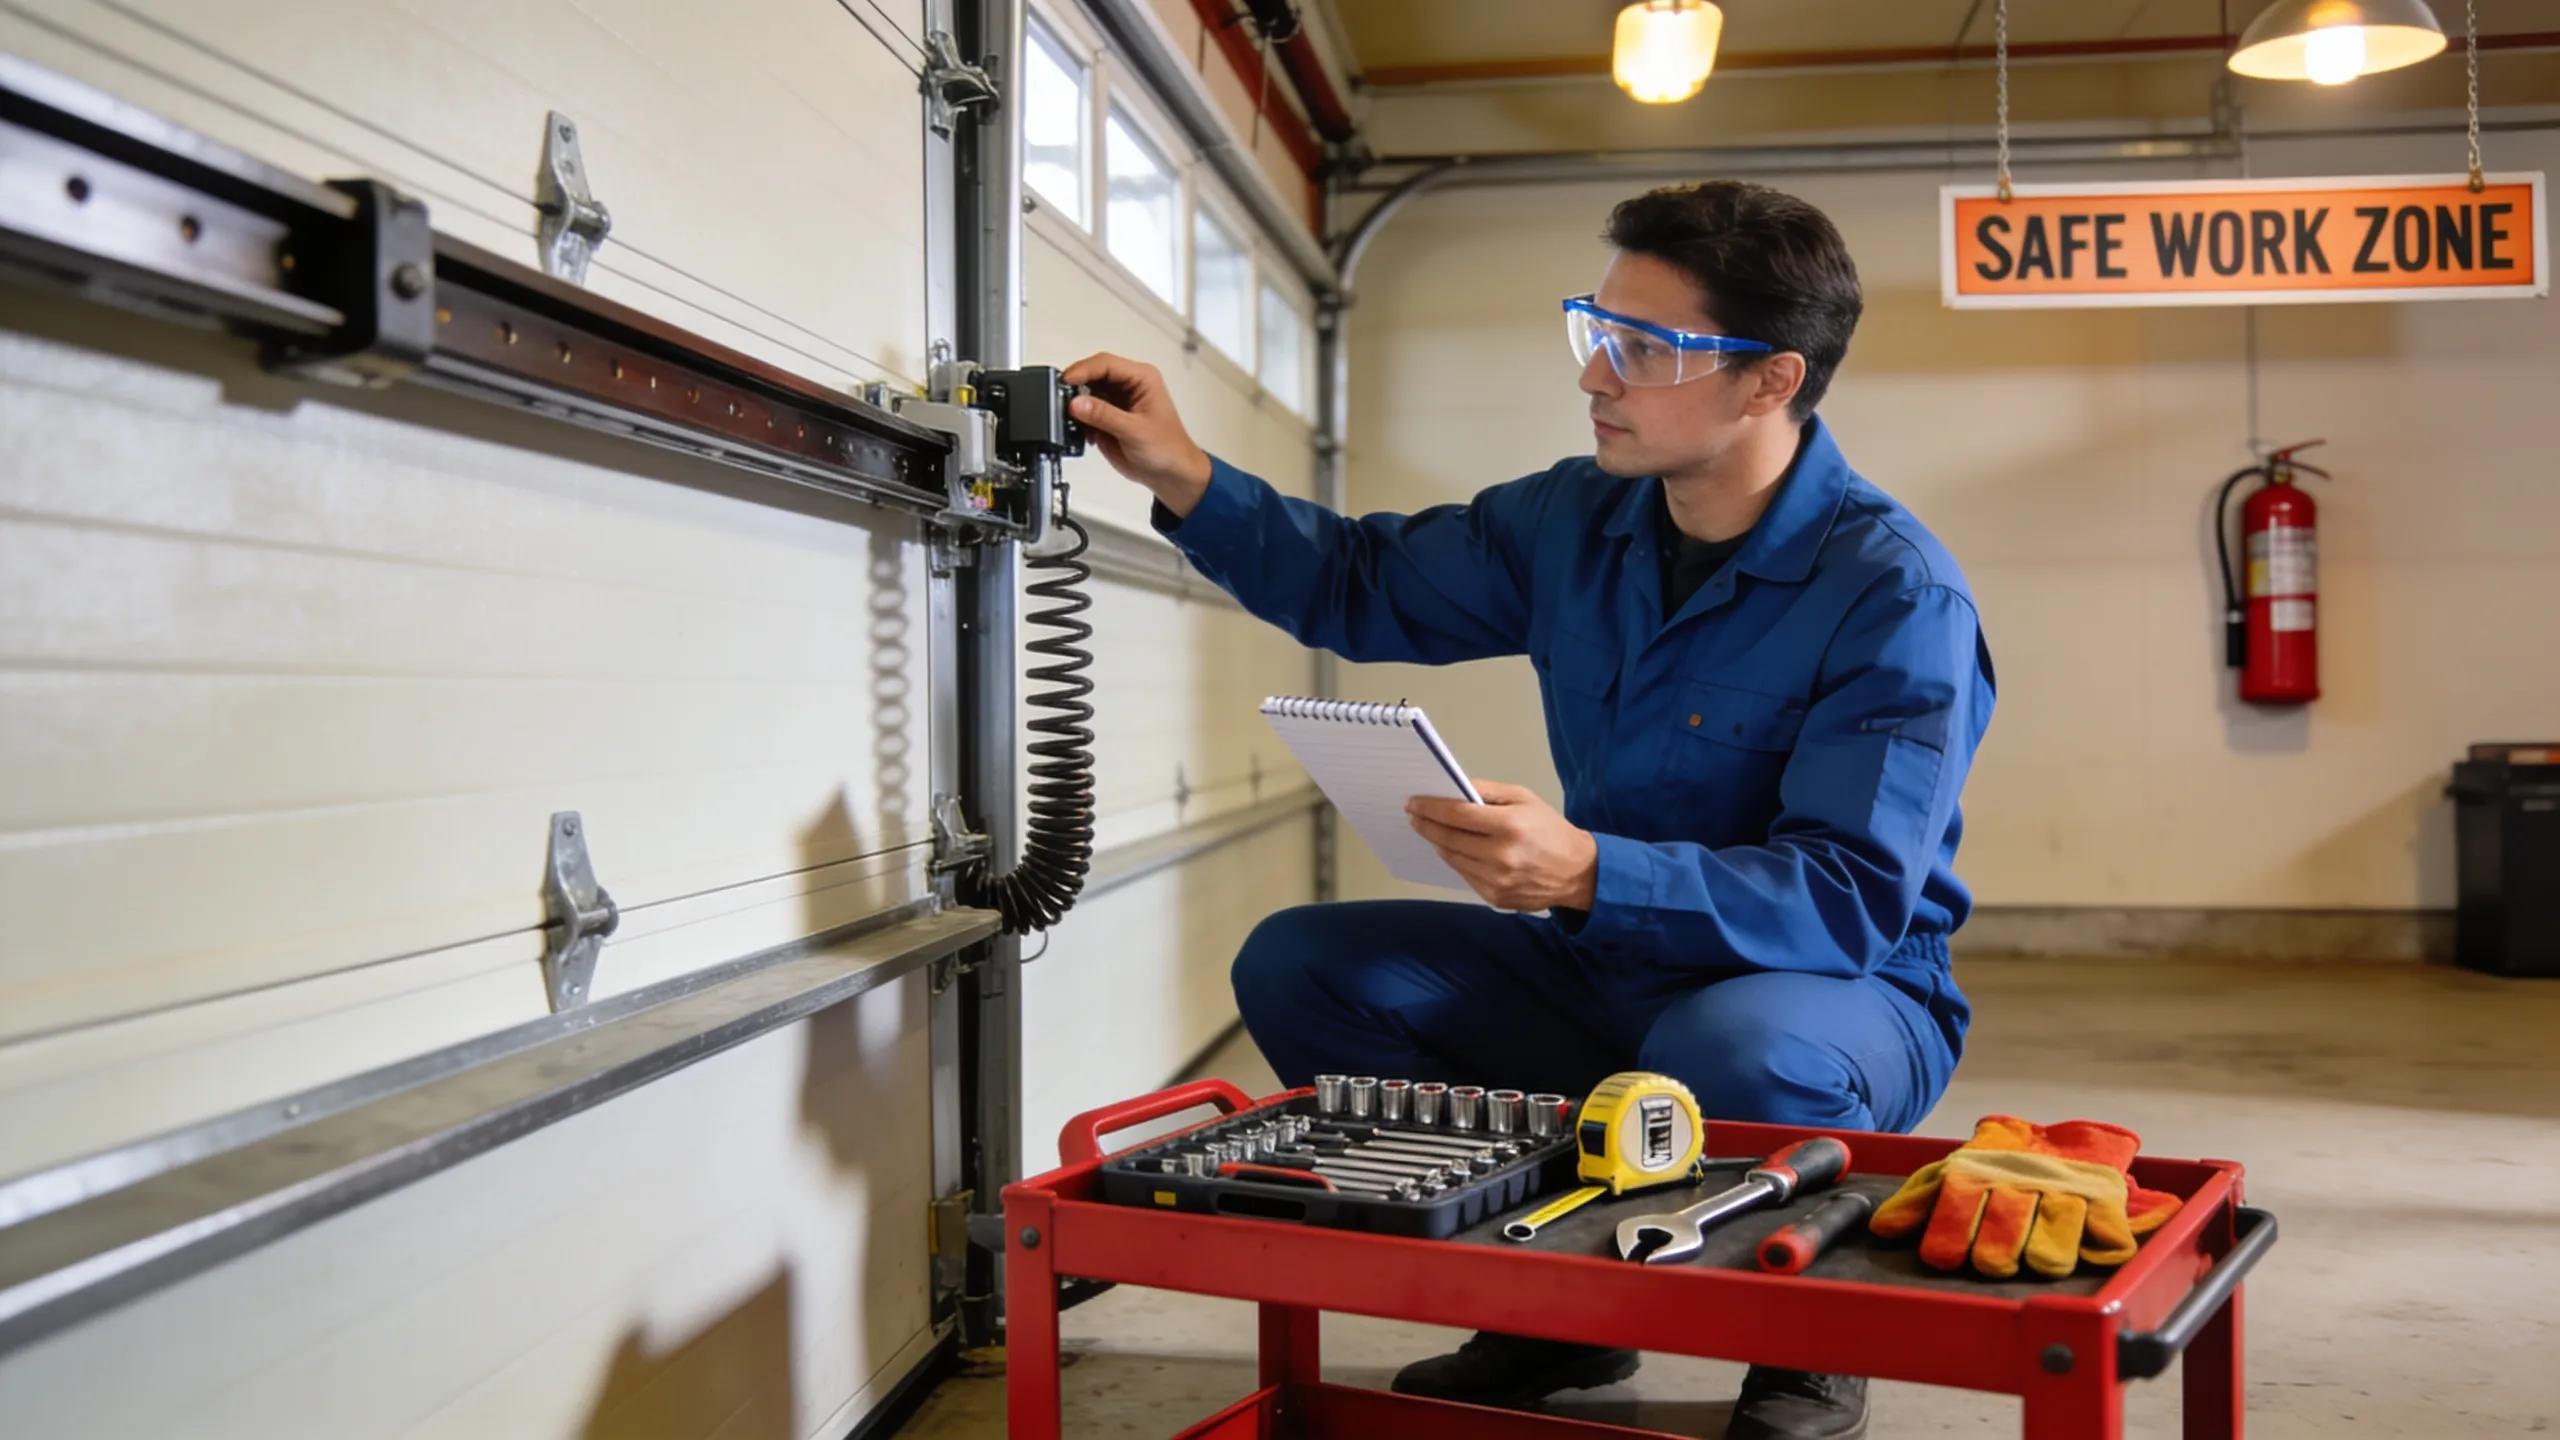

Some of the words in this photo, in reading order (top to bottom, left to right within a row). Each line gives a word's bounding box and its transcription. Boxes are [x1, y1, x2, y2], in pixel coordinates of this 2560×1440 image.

[1974, 213, 2128, 282] SAFE
[2149, 207, 2332, 278] WORK
[2351, 202, 2515, 273] ZONE
